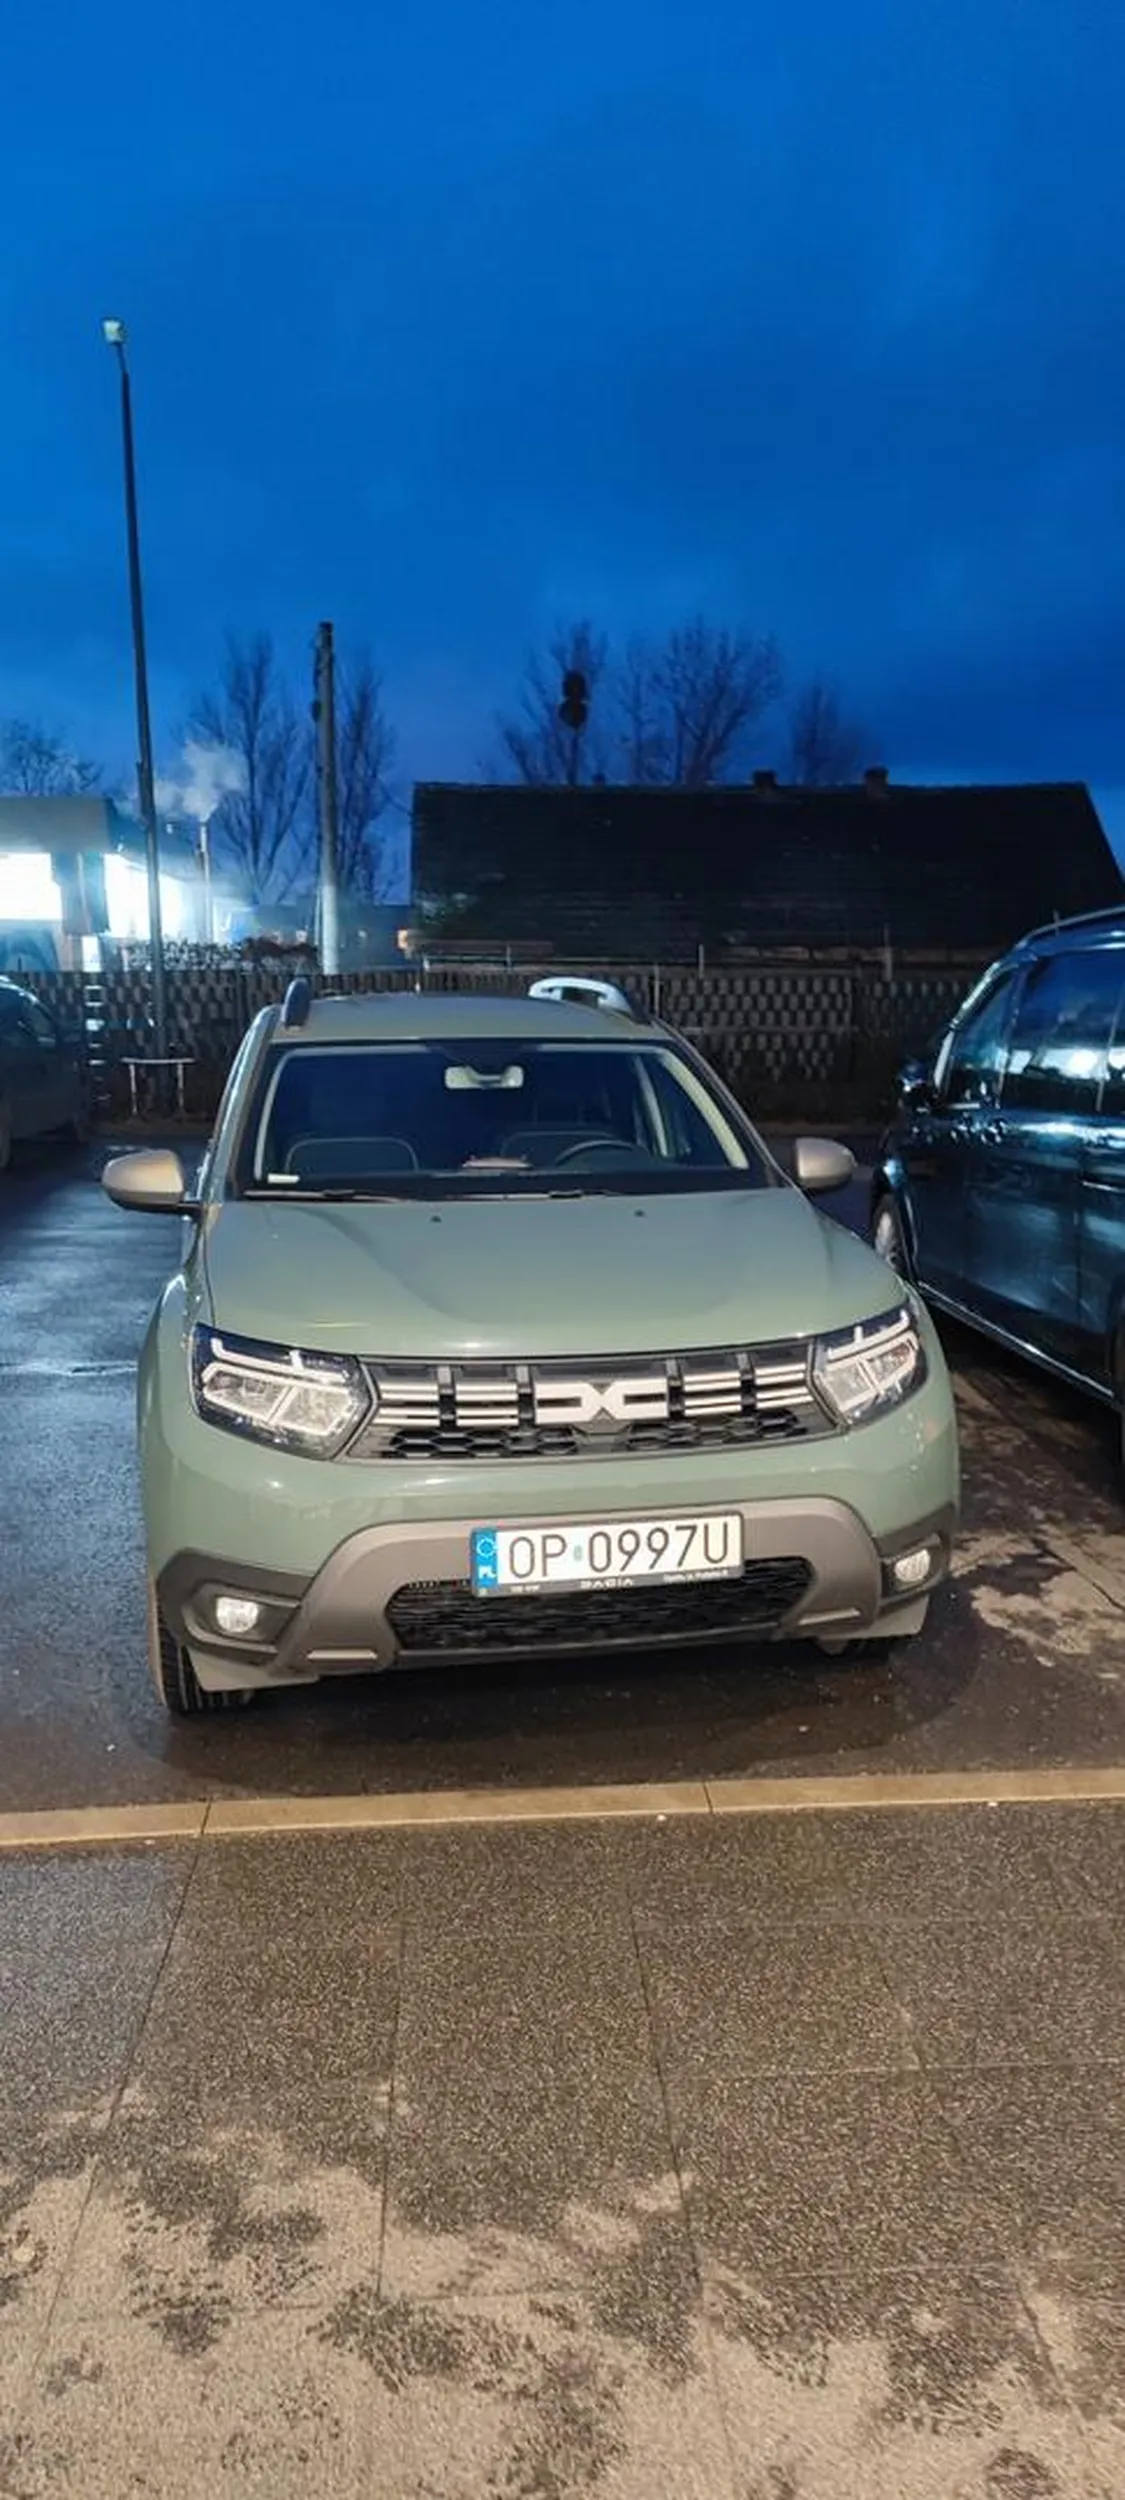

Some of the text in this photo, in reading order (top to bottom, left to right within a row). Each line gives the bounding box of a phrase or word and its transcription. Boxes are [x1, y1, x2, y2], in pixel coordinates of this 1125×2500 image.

[509, 1523, 728, 1578] OP 0997U
[478, 1565, 496, 1579] PL
